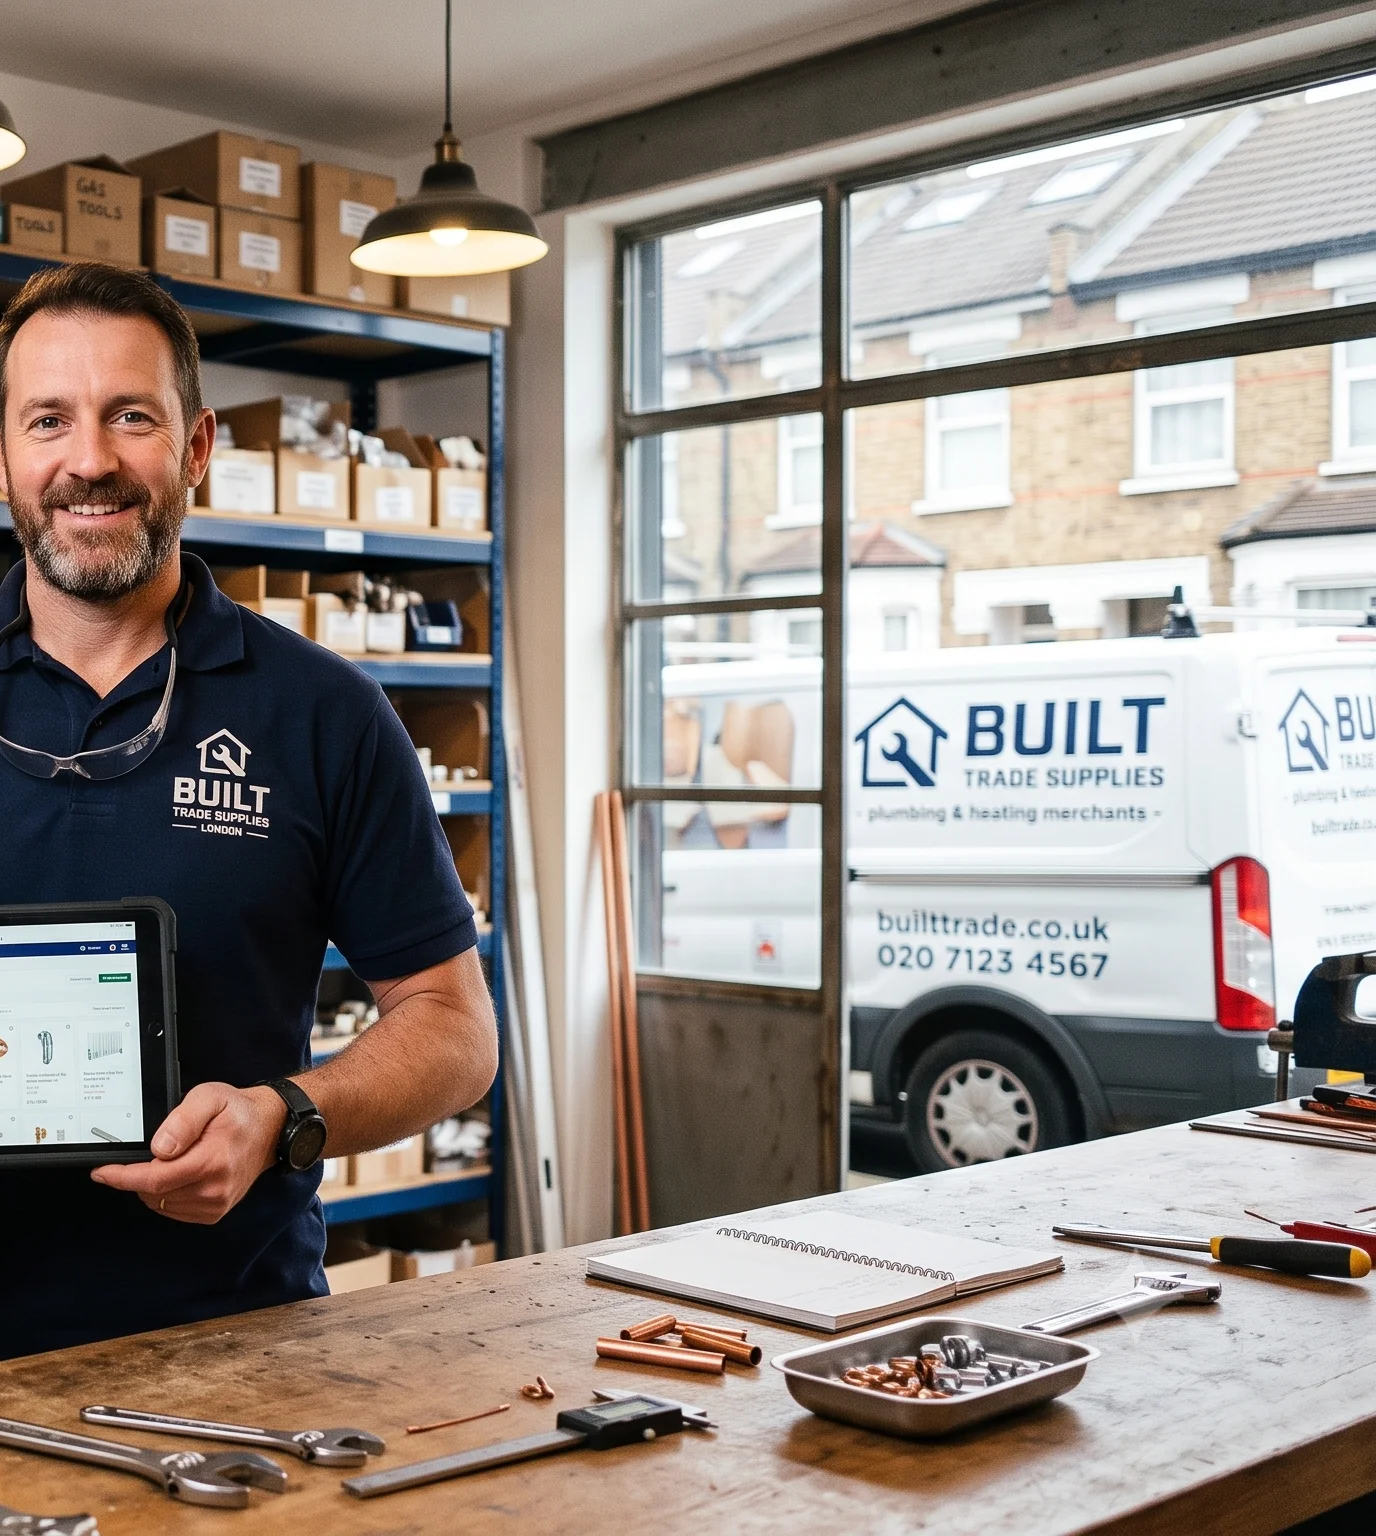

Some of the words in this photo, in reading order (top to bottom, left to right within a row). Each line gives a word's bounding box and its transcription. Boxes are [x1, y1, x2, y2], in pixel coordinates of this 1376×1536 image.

[966, 697, 1166, 757] BUILT
[964, 769, 1037, 787] TRADE
[1046, 767, 1165, 788] SUPPLIES
[173, 777, 270, 814] BUILT
[173, 806, 212, 820] TRADE
[215, 810, 270, 828] SUPPLIES
[868, 806, 947, 823] plumbing
[953, 807, 963, 819] &
[969, 805, 1037, 823] heating
[1042, 805, 1147, 821] merchants
[201, 824, 243, 837] LONDON
[877, 909, 1110, 941] builttrade.co.uk
[878, 944, 934, 969] 020
[946, 947, 1013, 973] 7123
[1027, 952, 1109, 979] 4567
